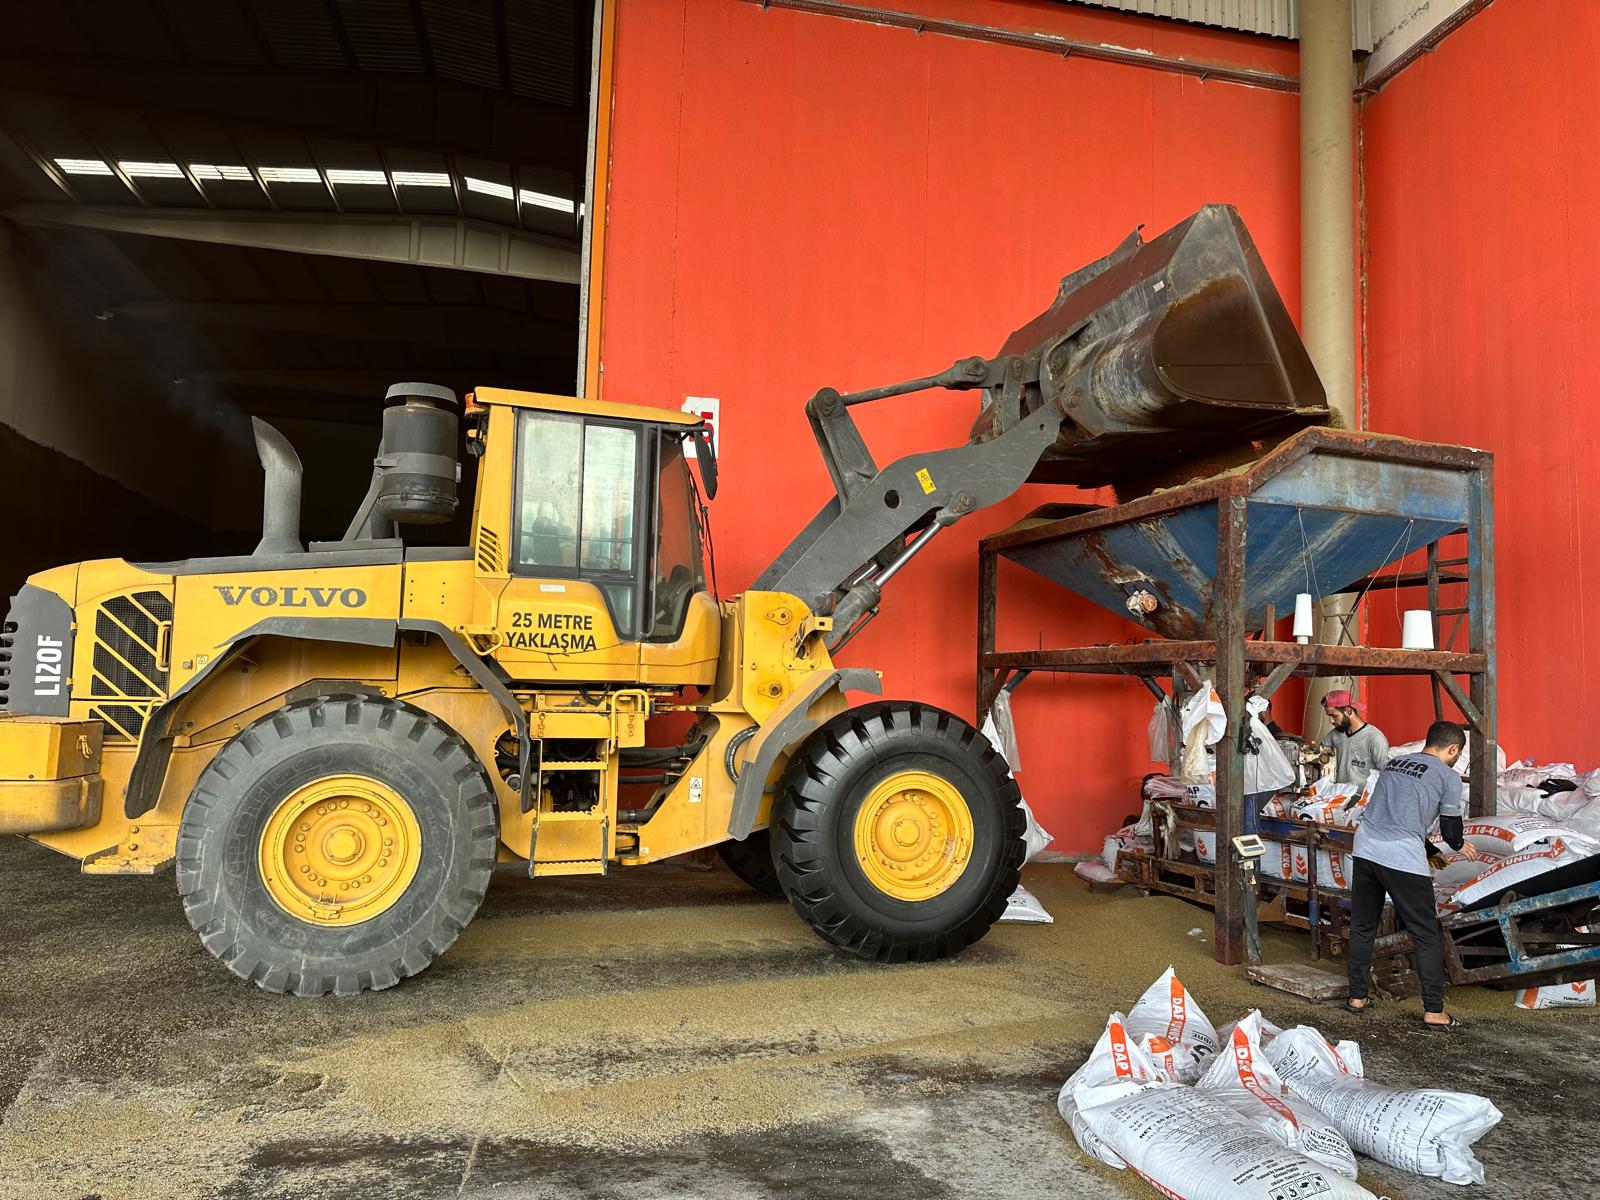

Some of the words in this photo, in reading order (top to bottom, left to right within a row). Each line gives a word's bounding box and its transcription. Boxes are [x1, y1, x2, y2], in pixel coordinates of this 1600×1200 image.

[213, 586, 367, 608] VOLVO
[512, 612, 533, 628] 25
[538, 613, 593, 630] METRE
[505, 632, 597, 653] YAKLAŞMA
[34, 635, 63, 696] L120F
[1475, 825, 1499, 836] 18-46
[1113, 1043, 1129, 1071] DAP
